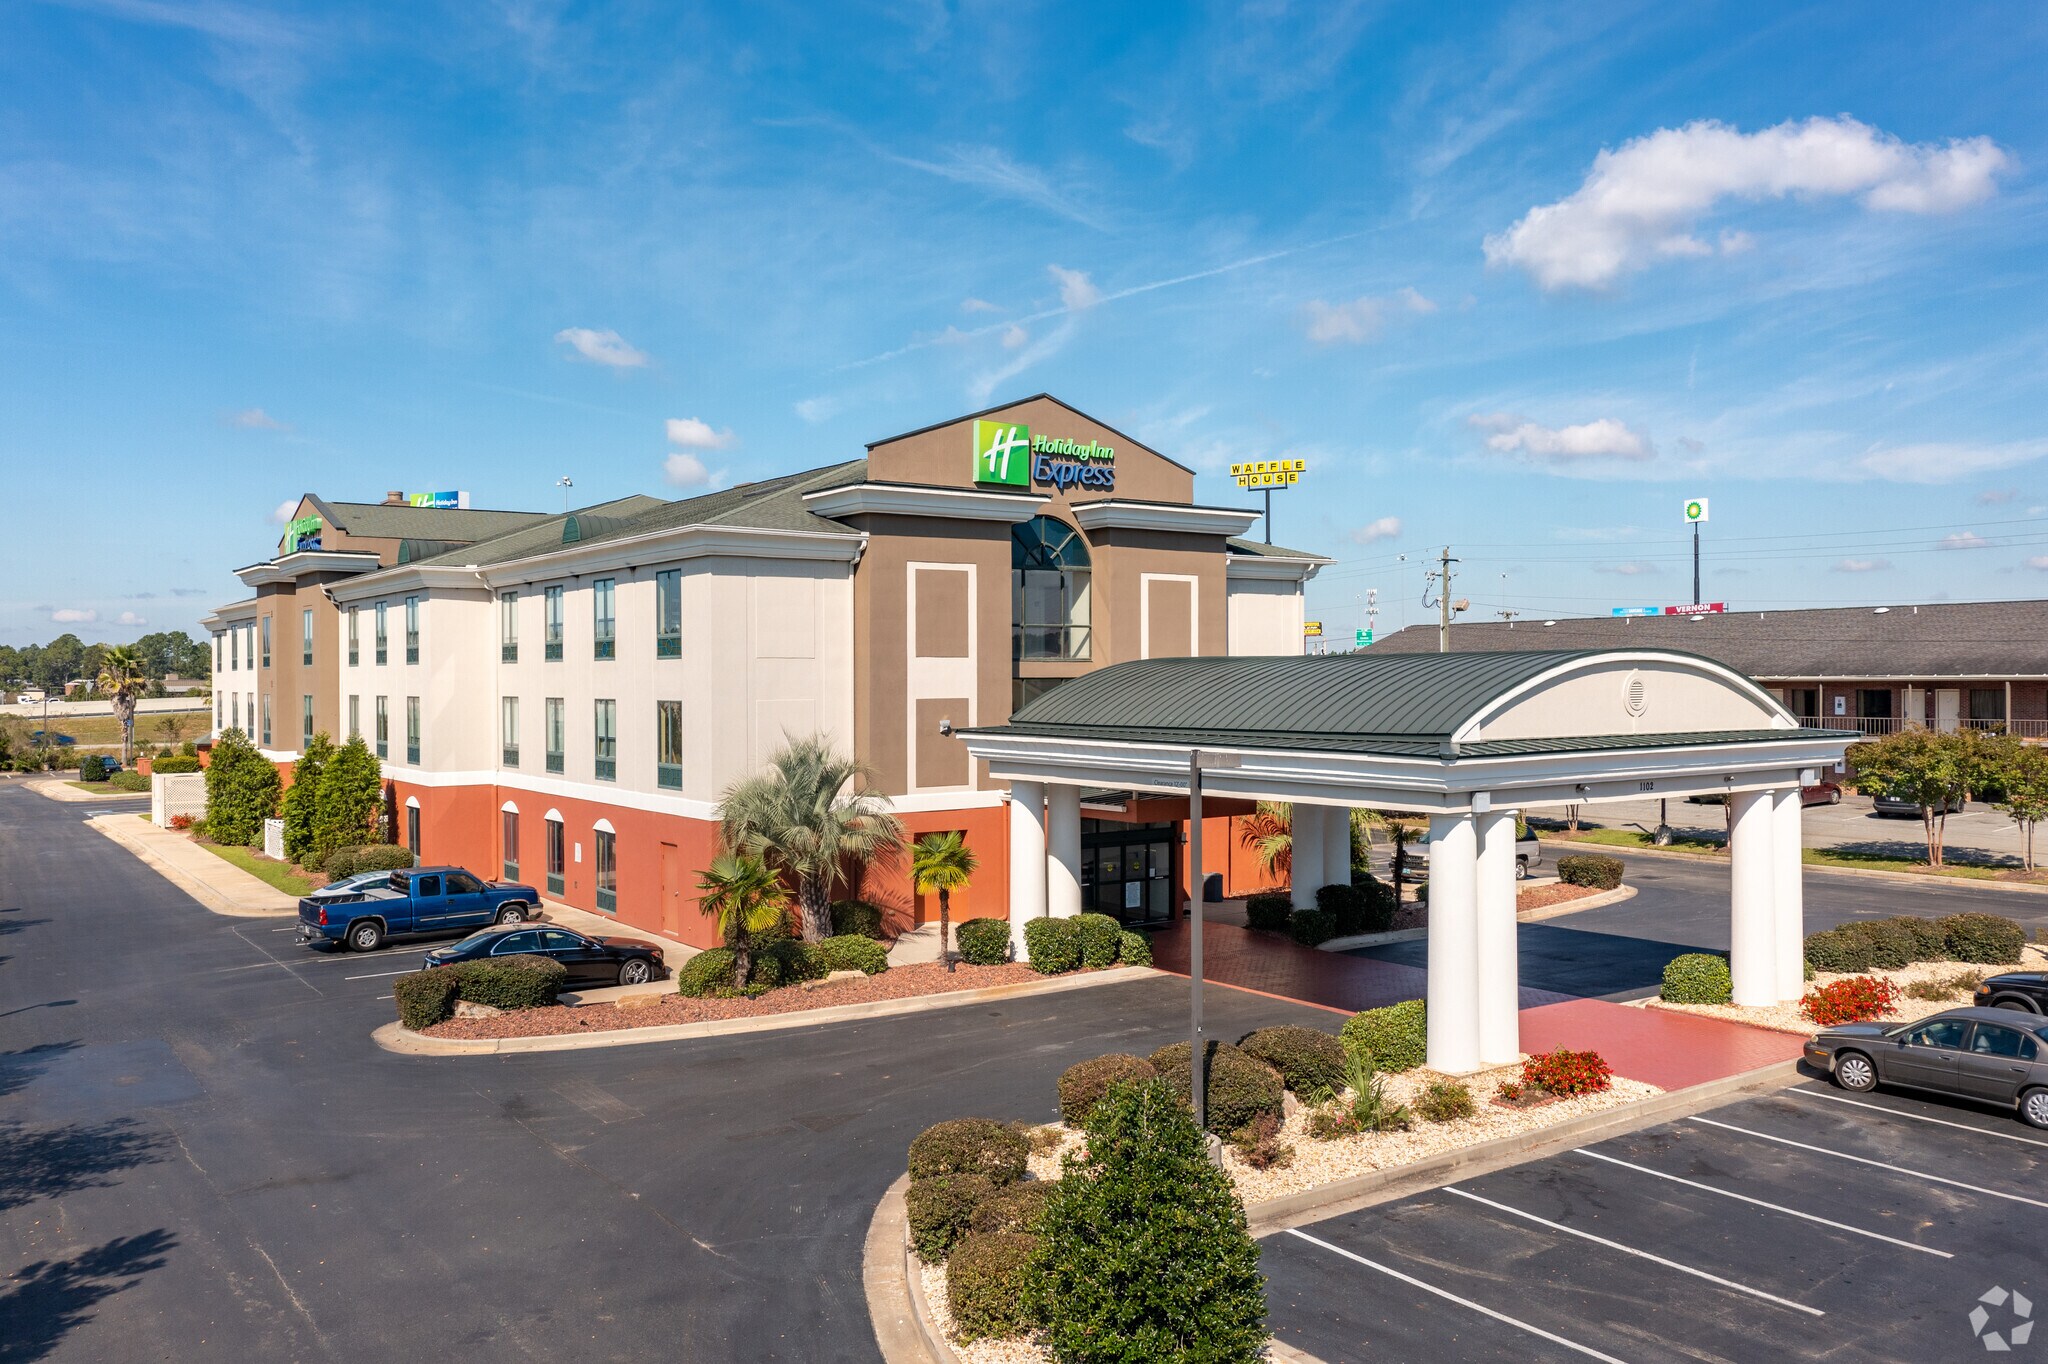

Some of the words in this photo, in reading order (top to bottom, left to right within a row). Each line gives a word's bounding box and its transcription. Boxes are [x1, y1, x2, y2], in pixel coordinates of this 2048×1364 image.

[1033, 435, 1090, 460] Holiday
[1090, 439, 1114, 459] Inn
[1033, 455, 1115, 489] Express
[1232, 461, 1302, 473] WAFFLE
[1239, 474, 1295, 485] HOUSE
[1676, 604, 1710, 612] VERNON
[1640, 781, 1654, 791] 1102
